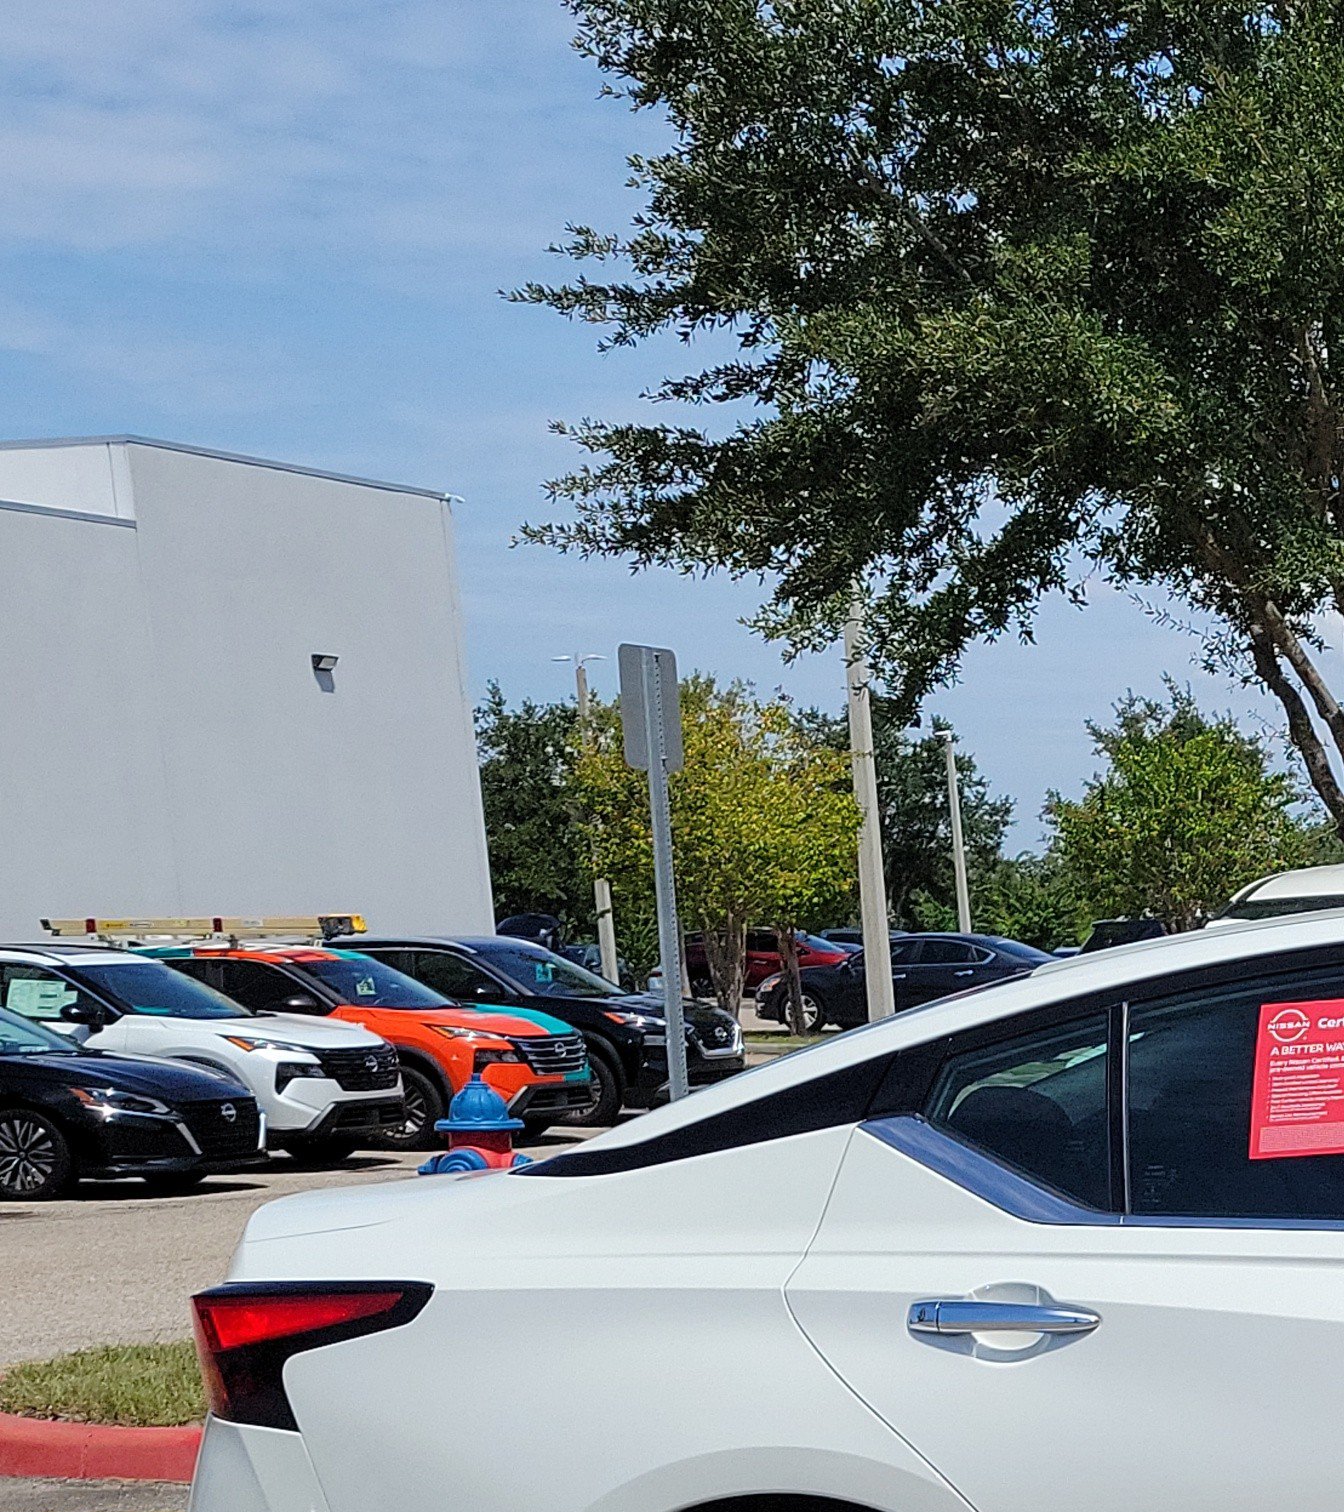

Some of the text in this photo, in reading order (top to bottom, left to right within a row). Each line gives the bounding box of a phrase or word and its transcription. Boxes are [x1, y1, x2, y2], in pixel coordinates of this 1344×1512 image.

[1267, 1020, 1311, 1031] NISSAN
[1270, 1047, 1280, 1057] A
[1281, 1044, 1324, 1056] BETTER
